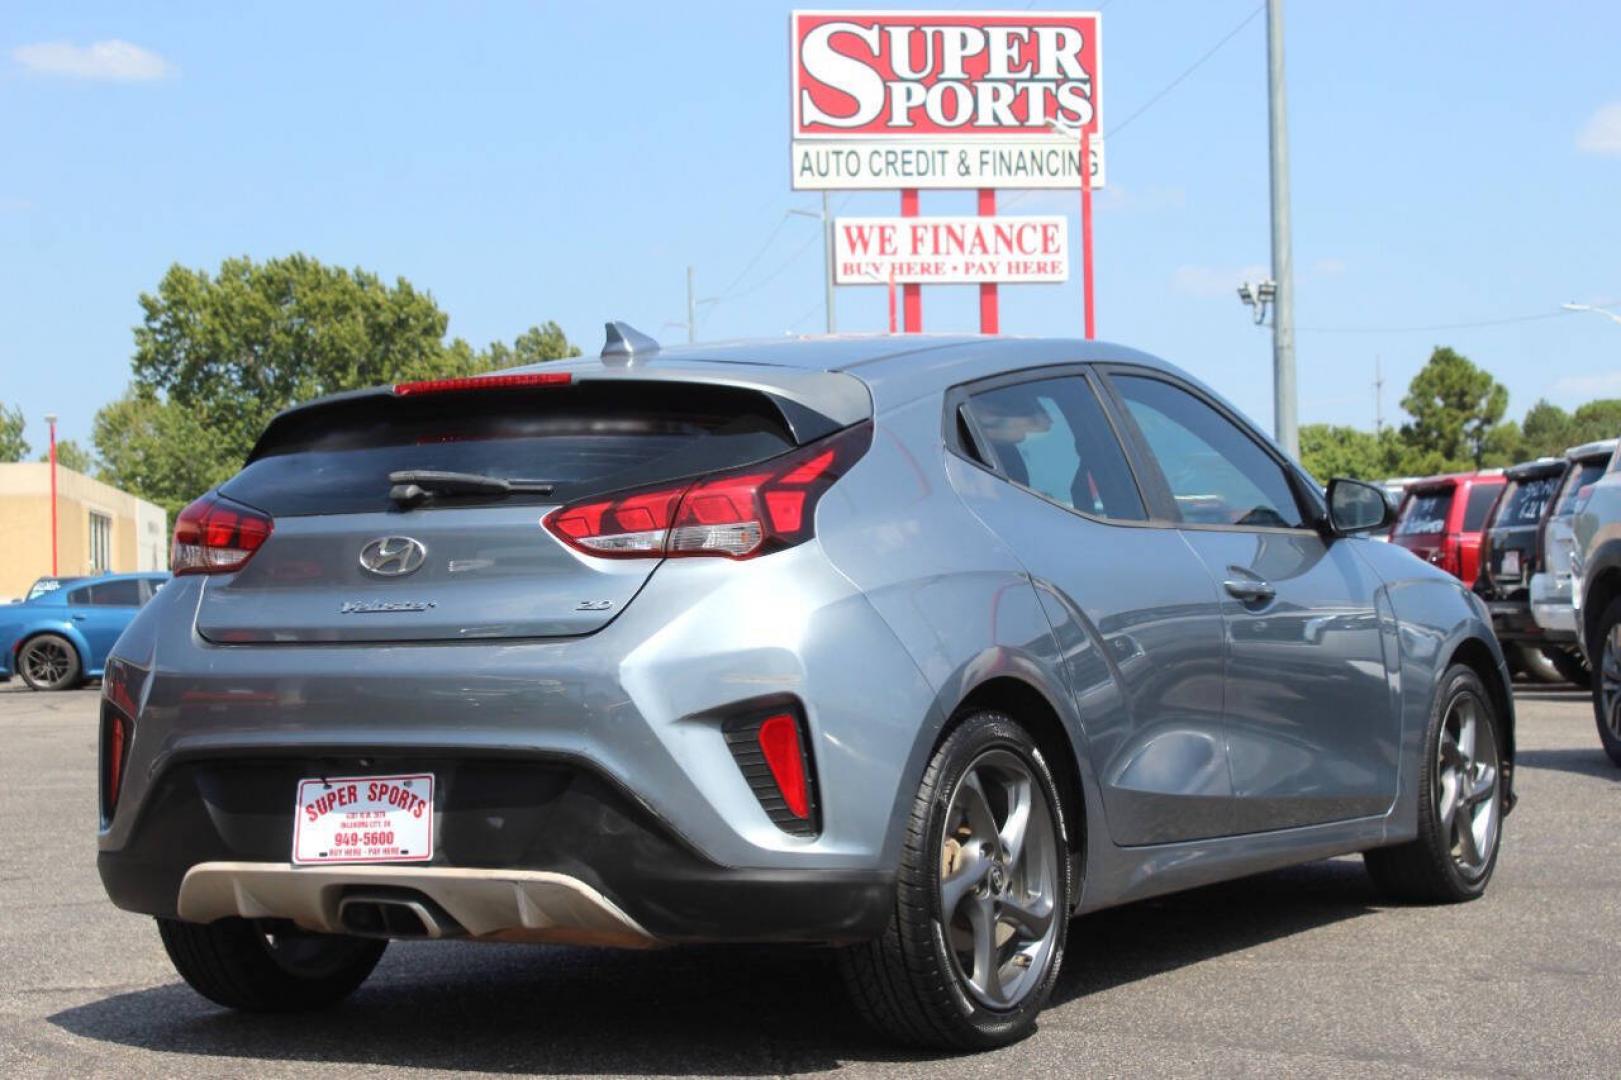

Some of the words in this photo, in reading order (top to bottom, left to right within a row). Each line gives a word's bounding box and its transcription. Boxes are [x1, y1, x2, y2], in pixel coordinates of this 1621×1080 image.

[800, 150, 861, 177] AUTO
[868, 150, 949, 177] CREDIT
[956, 150, 971, 177] &
[842, 224, 898, 256] WE
[910, 223, 1061, 256] FINANCE
[842, 261, 882, 276] BUY
[889, 260, 946, 276] HERE
[964, 260, 1006, 275] PAY
[1007, 260, 1063, 275] HERE
[305, 784, 358, 822] SUPER
[368, 782, 427, 819] SPORTS
[334, 831, 395, 847] 949-5600
